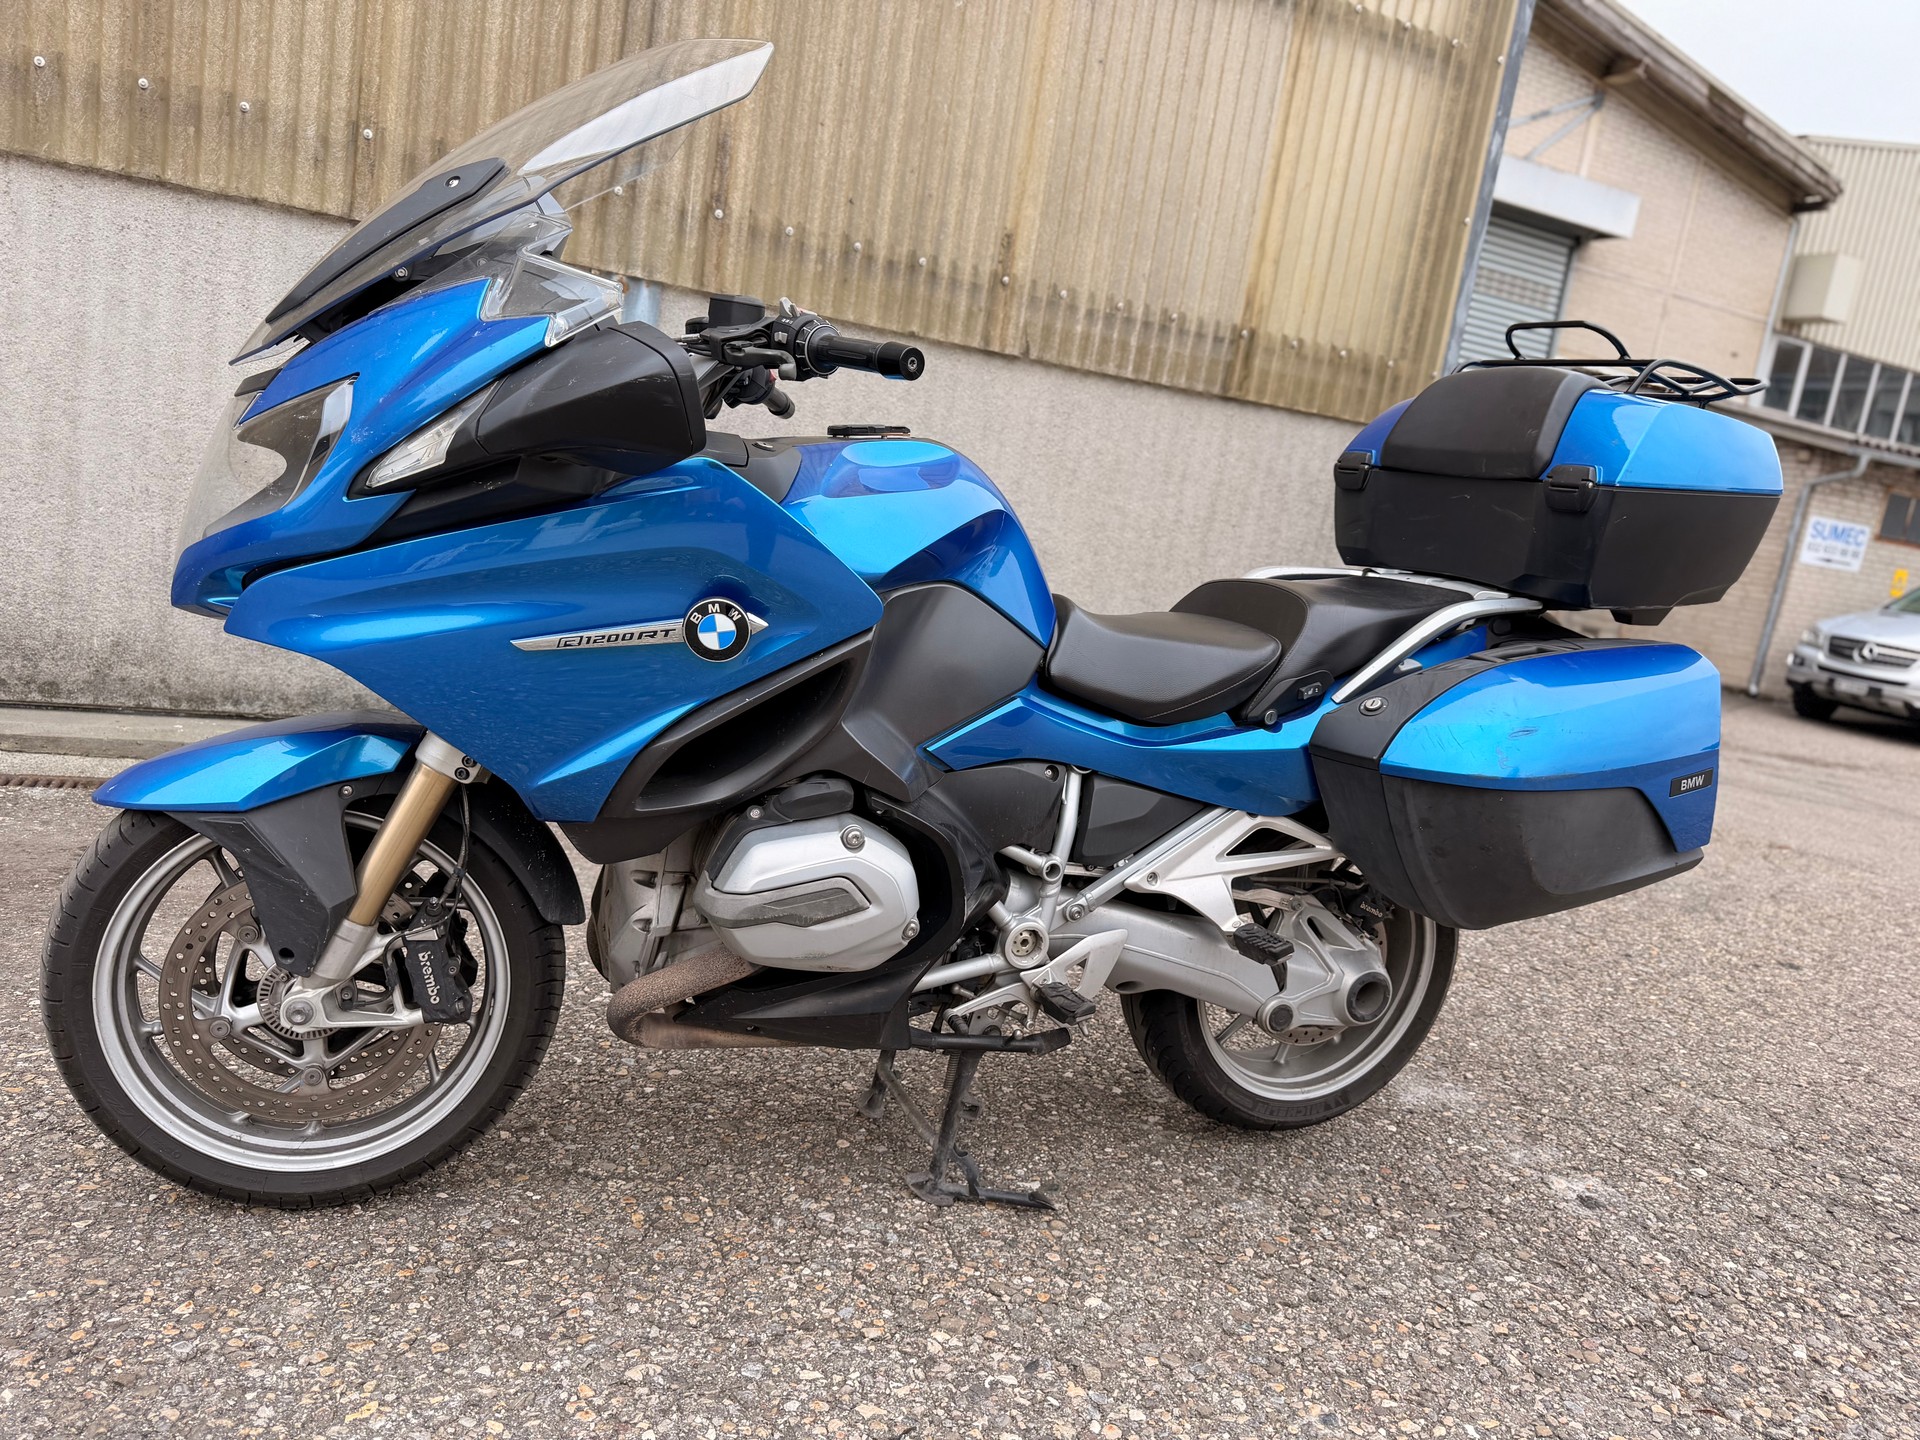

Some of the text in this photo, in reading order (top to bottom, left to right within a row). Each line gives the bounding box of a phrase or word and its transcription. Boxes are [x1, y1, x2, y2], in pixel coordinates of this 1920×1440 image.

[1811, 520, 1867, 547] SUMEC
[689, 602, 742, 625] BMW
[1680, 774, 1705, 791] BMW
[1360, 901, 1383, 918] brembo
[417, 950, 441, 1005] brembo
